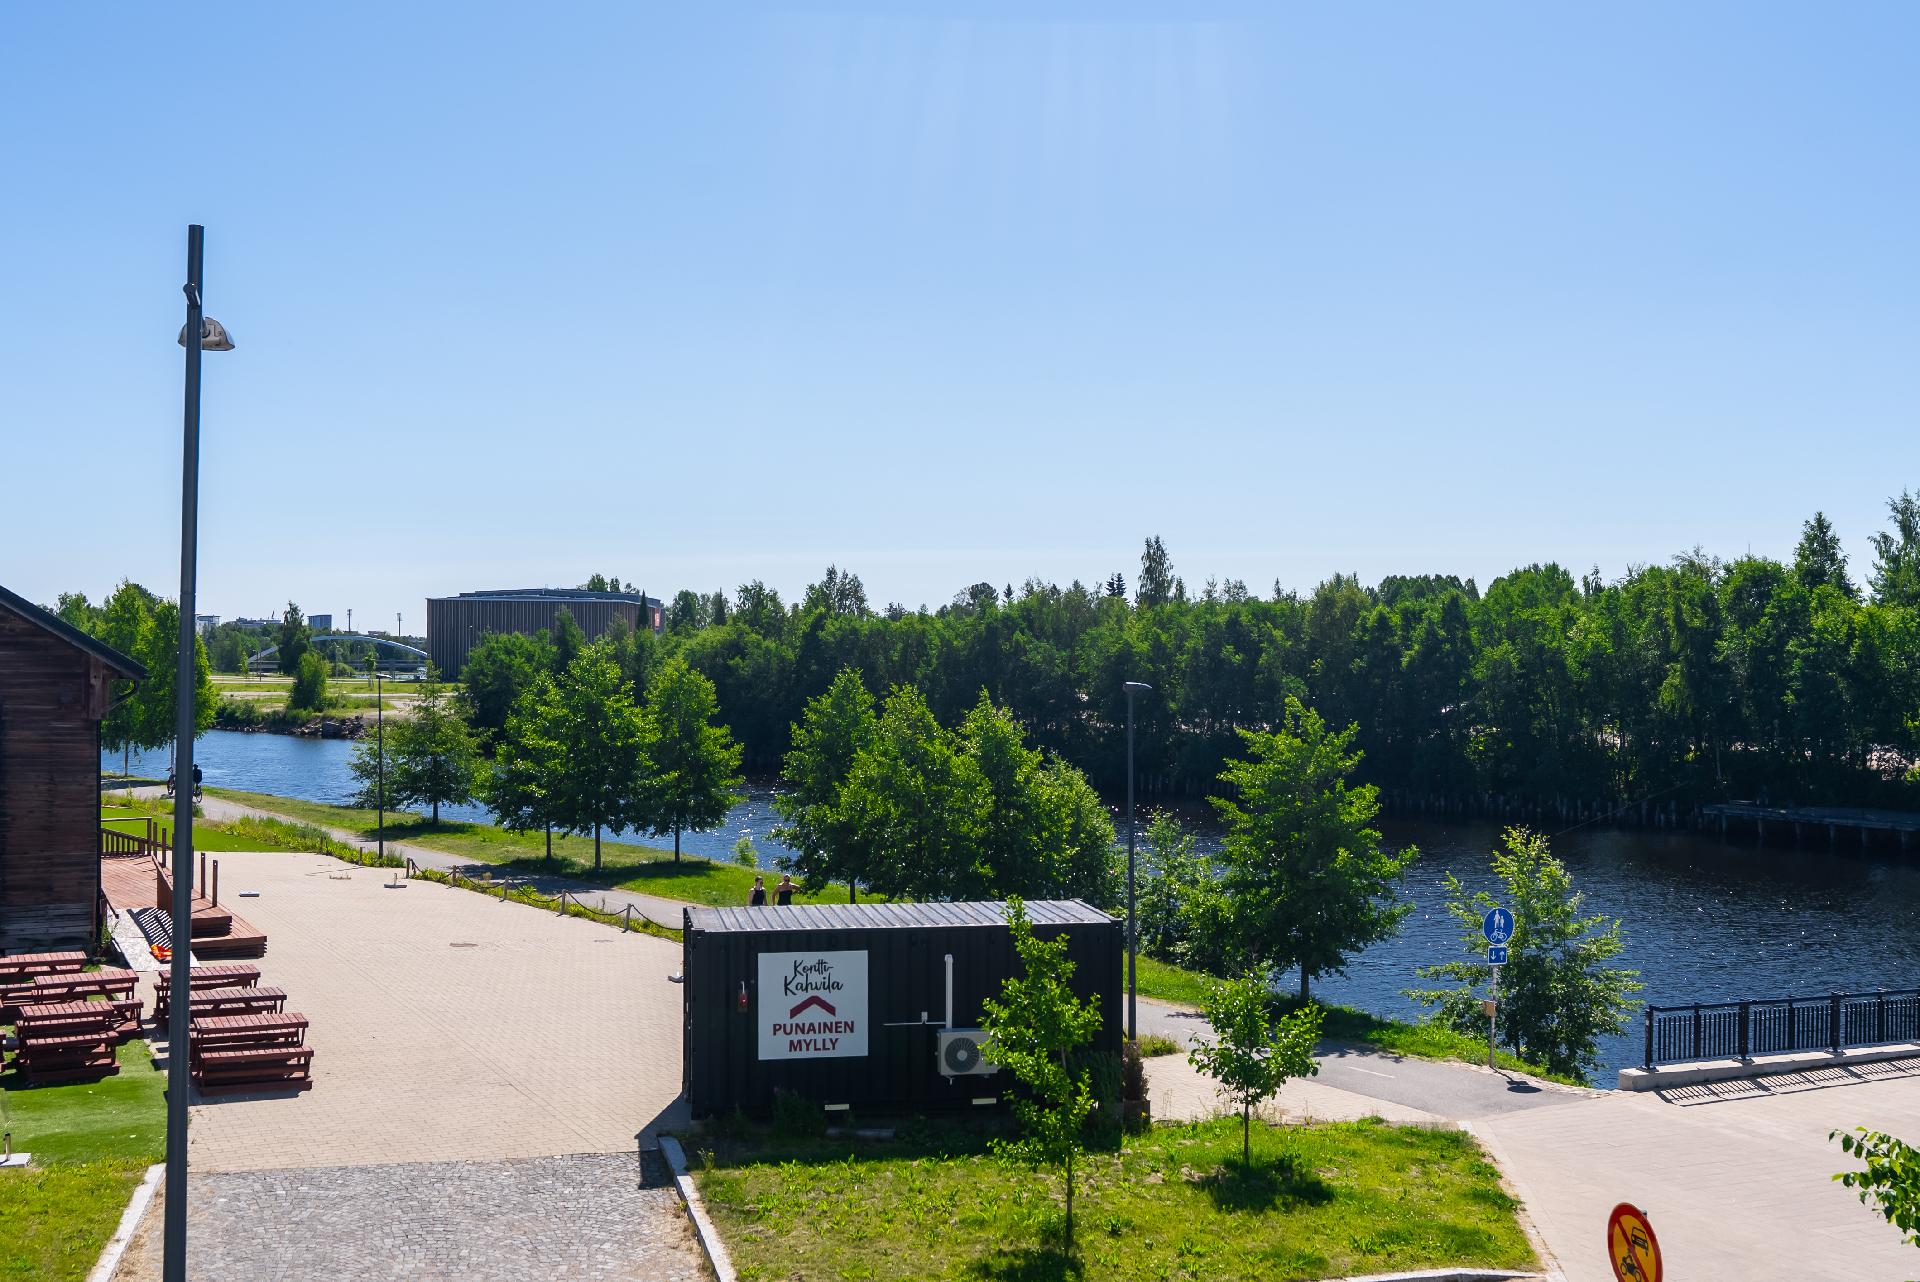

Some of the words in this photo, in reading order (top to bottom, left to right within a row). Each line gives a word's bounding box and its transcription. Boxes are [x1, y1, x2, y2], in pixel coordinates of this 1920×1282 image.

[784, 972, 844, 996] Kahvila
[773, 1021, 854, 1036] PUNAINEN
[788, 1038, 839, 1052] MYLLY
